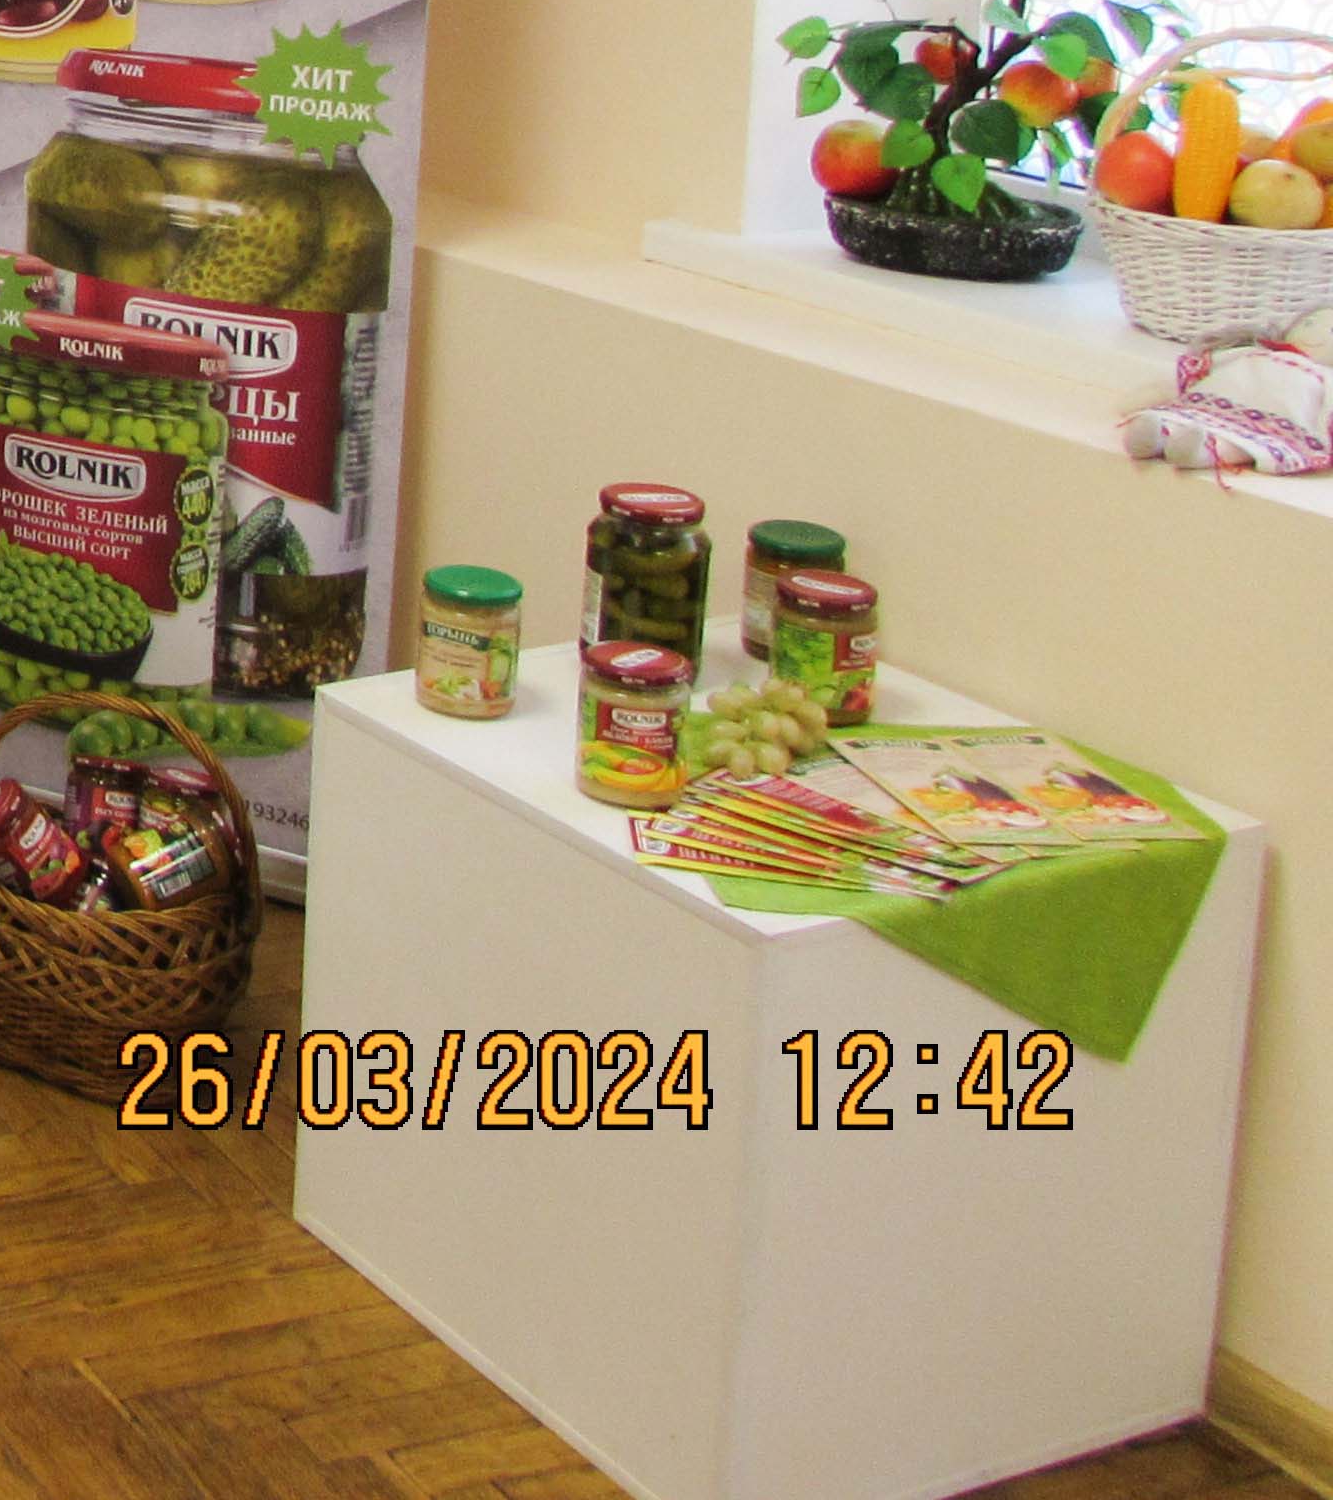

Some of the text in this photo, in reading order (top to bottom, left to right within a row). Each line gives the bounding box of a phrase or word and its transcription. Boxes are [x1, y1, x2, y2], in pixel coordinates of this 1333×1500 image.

[89, 59, 145, 78] ROLNIK
[291, 64, 353, 94] ХИТ
[268, 92, 375, 123] ПРОДАЖ
[59, 337, 124, 361] ROLNIK
[14, 445, 134, 491] ROLNIK
[3, 507, 144, 545] из мозговых сортов
[76, 505, 170, 535] ЗЕЛЕНЫЙ
[13, 524, 132, 561] ВЫСШИЙ СОРТ
